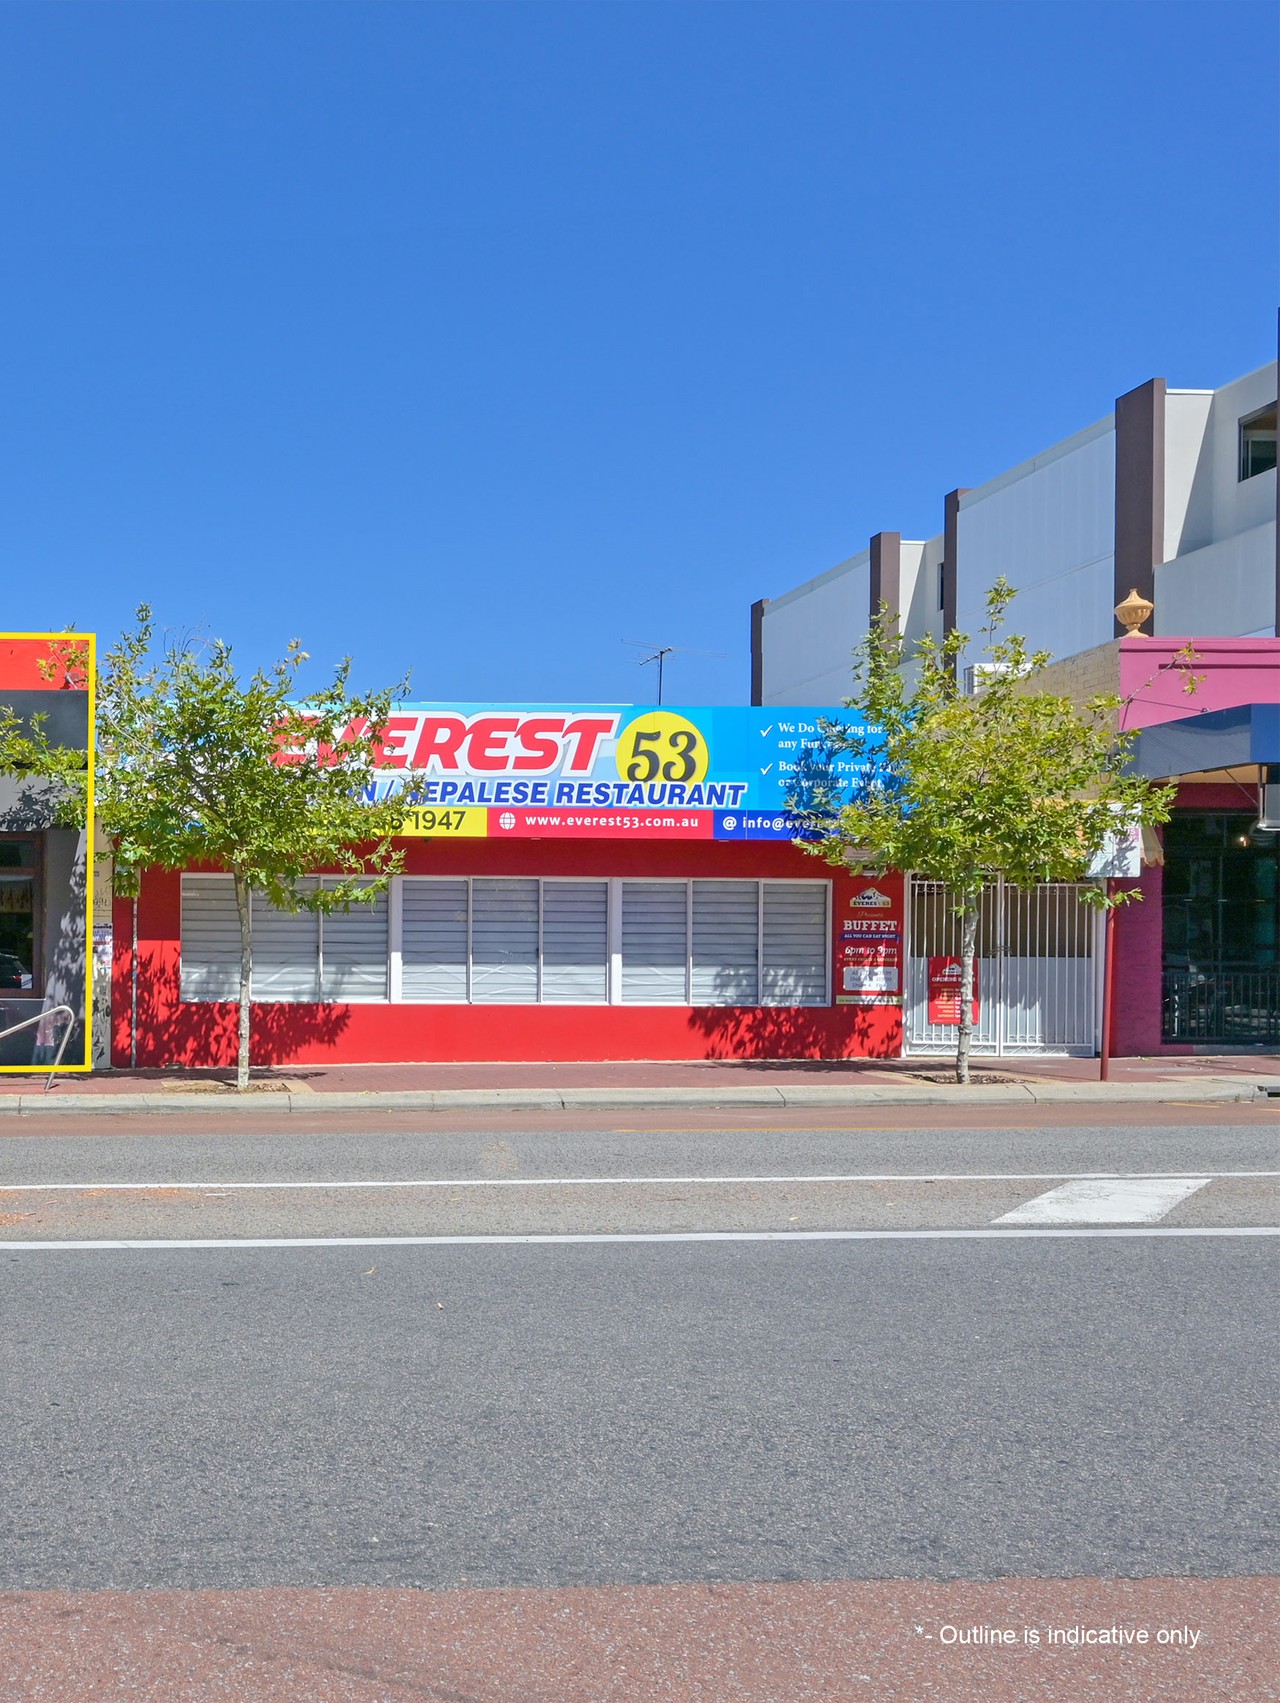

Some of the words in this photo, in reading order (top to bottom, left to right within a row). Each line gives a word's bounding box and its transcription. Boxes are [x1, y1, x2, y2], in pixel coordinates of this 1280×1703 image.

[778, 723, 795, 733] We
[798, 723, 815, 733] Do
[867, 724, 883, 734] for
[268, 716, 616, 770] EVEREST
[626, 730, 697, 783] 53
[778, 740, 798, 751] any
[779, 761, 807, 772] Book
[810, 764, 834, 774] your
[409, 781, 549, 805] EPALESE
[556, 783, 746, 806] RESTAURANT
[414, 810, 466, 831] 1947
[525, 814, 699, 829] www.everest53.com.au
[843, 920, 897, 931] BUFFET
[845, 946, 865, 956] 6pm
[867, 946, 875, 954] to
[877, 946, 897, 956] 9pm
